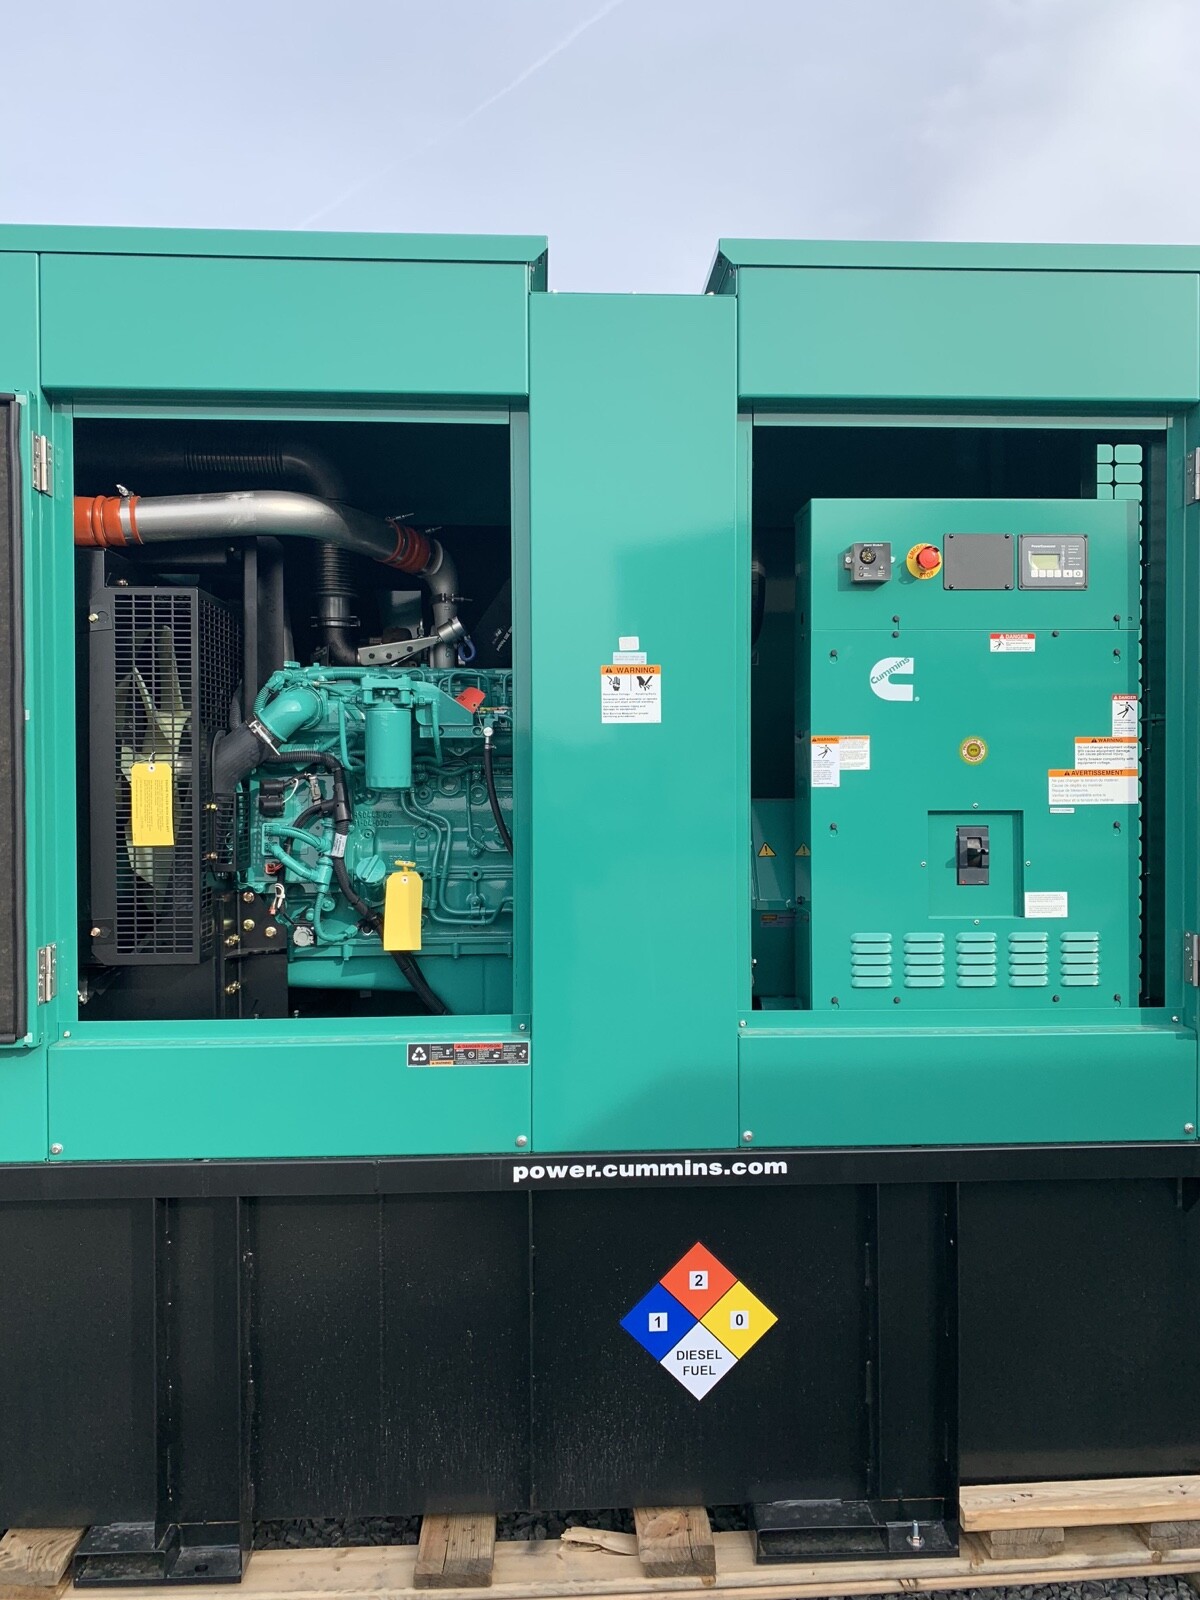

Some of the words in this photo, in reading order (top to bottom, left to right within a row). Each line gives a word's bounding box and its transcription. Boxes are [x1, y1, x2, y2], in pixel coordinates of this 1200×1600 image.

[918, 570, 934, 579] STOP
[616, 666, 655, 674] WARNING
[870, 657, 910, 685] Cummins
[512, 1159, 789, 1183] power.cummins.com
[694, 1274, 704, 1287] 2
[653, 1315, 662, 1329] 1
[735, 1314, 744, 1327] 0
[676, 1349, 723, 1361] DIESEL
[682, 1365, 717, 1377] FUEL
